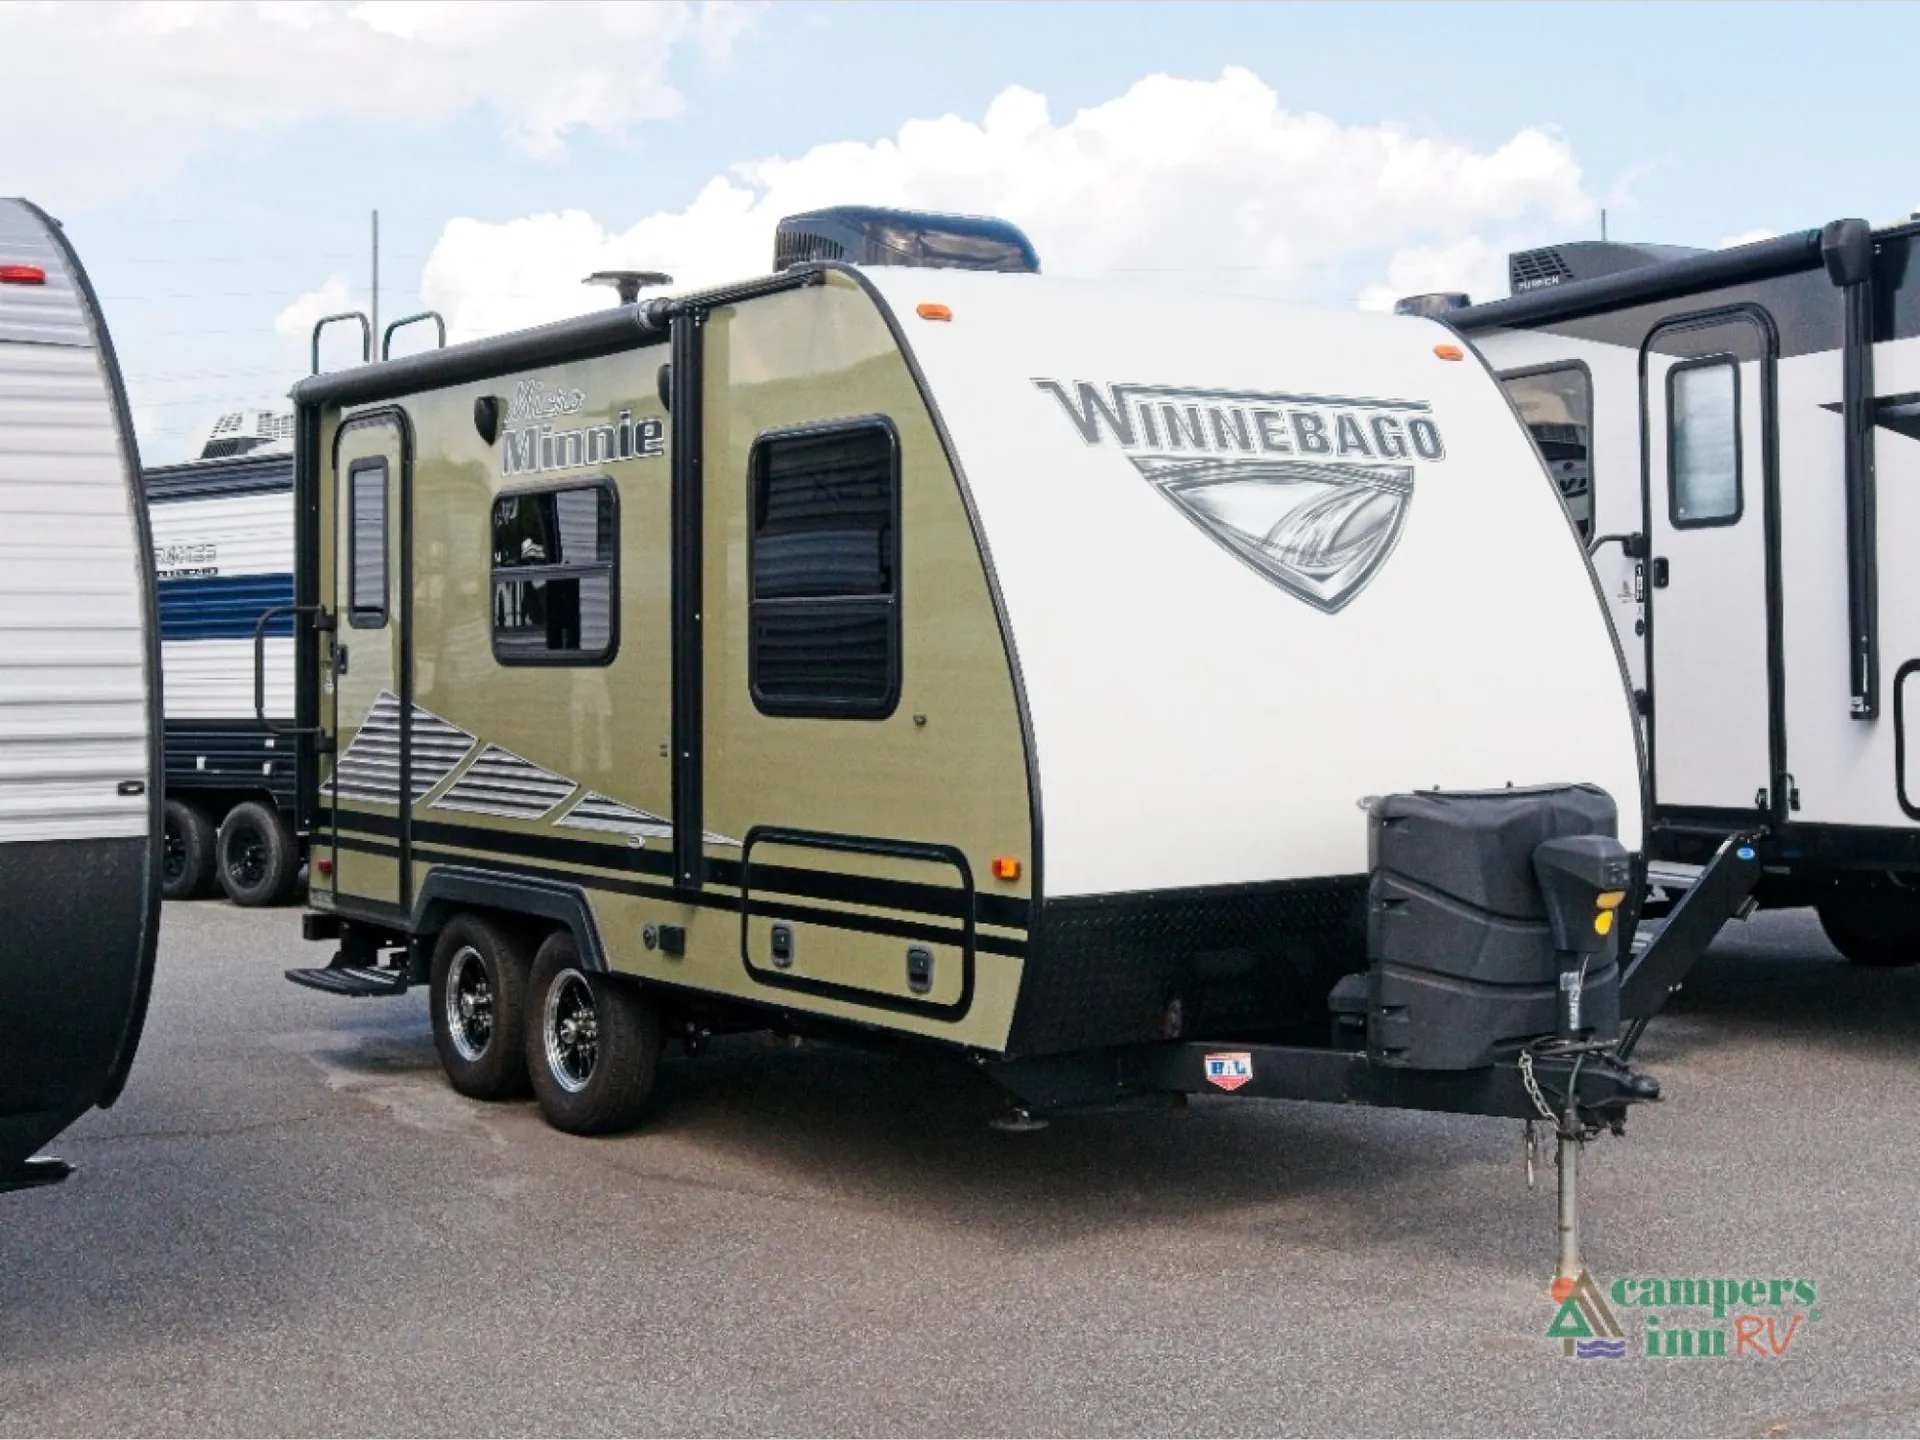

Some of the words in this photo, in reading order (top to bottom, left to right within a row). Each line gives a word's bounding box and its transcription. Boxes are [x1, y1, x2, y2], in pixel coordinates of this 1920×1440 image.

[504, 379, 587, 423] Micro
[1029, 377, 1447, 463] WINNEBAGO
[502, 408, 665, 476] Minnie
